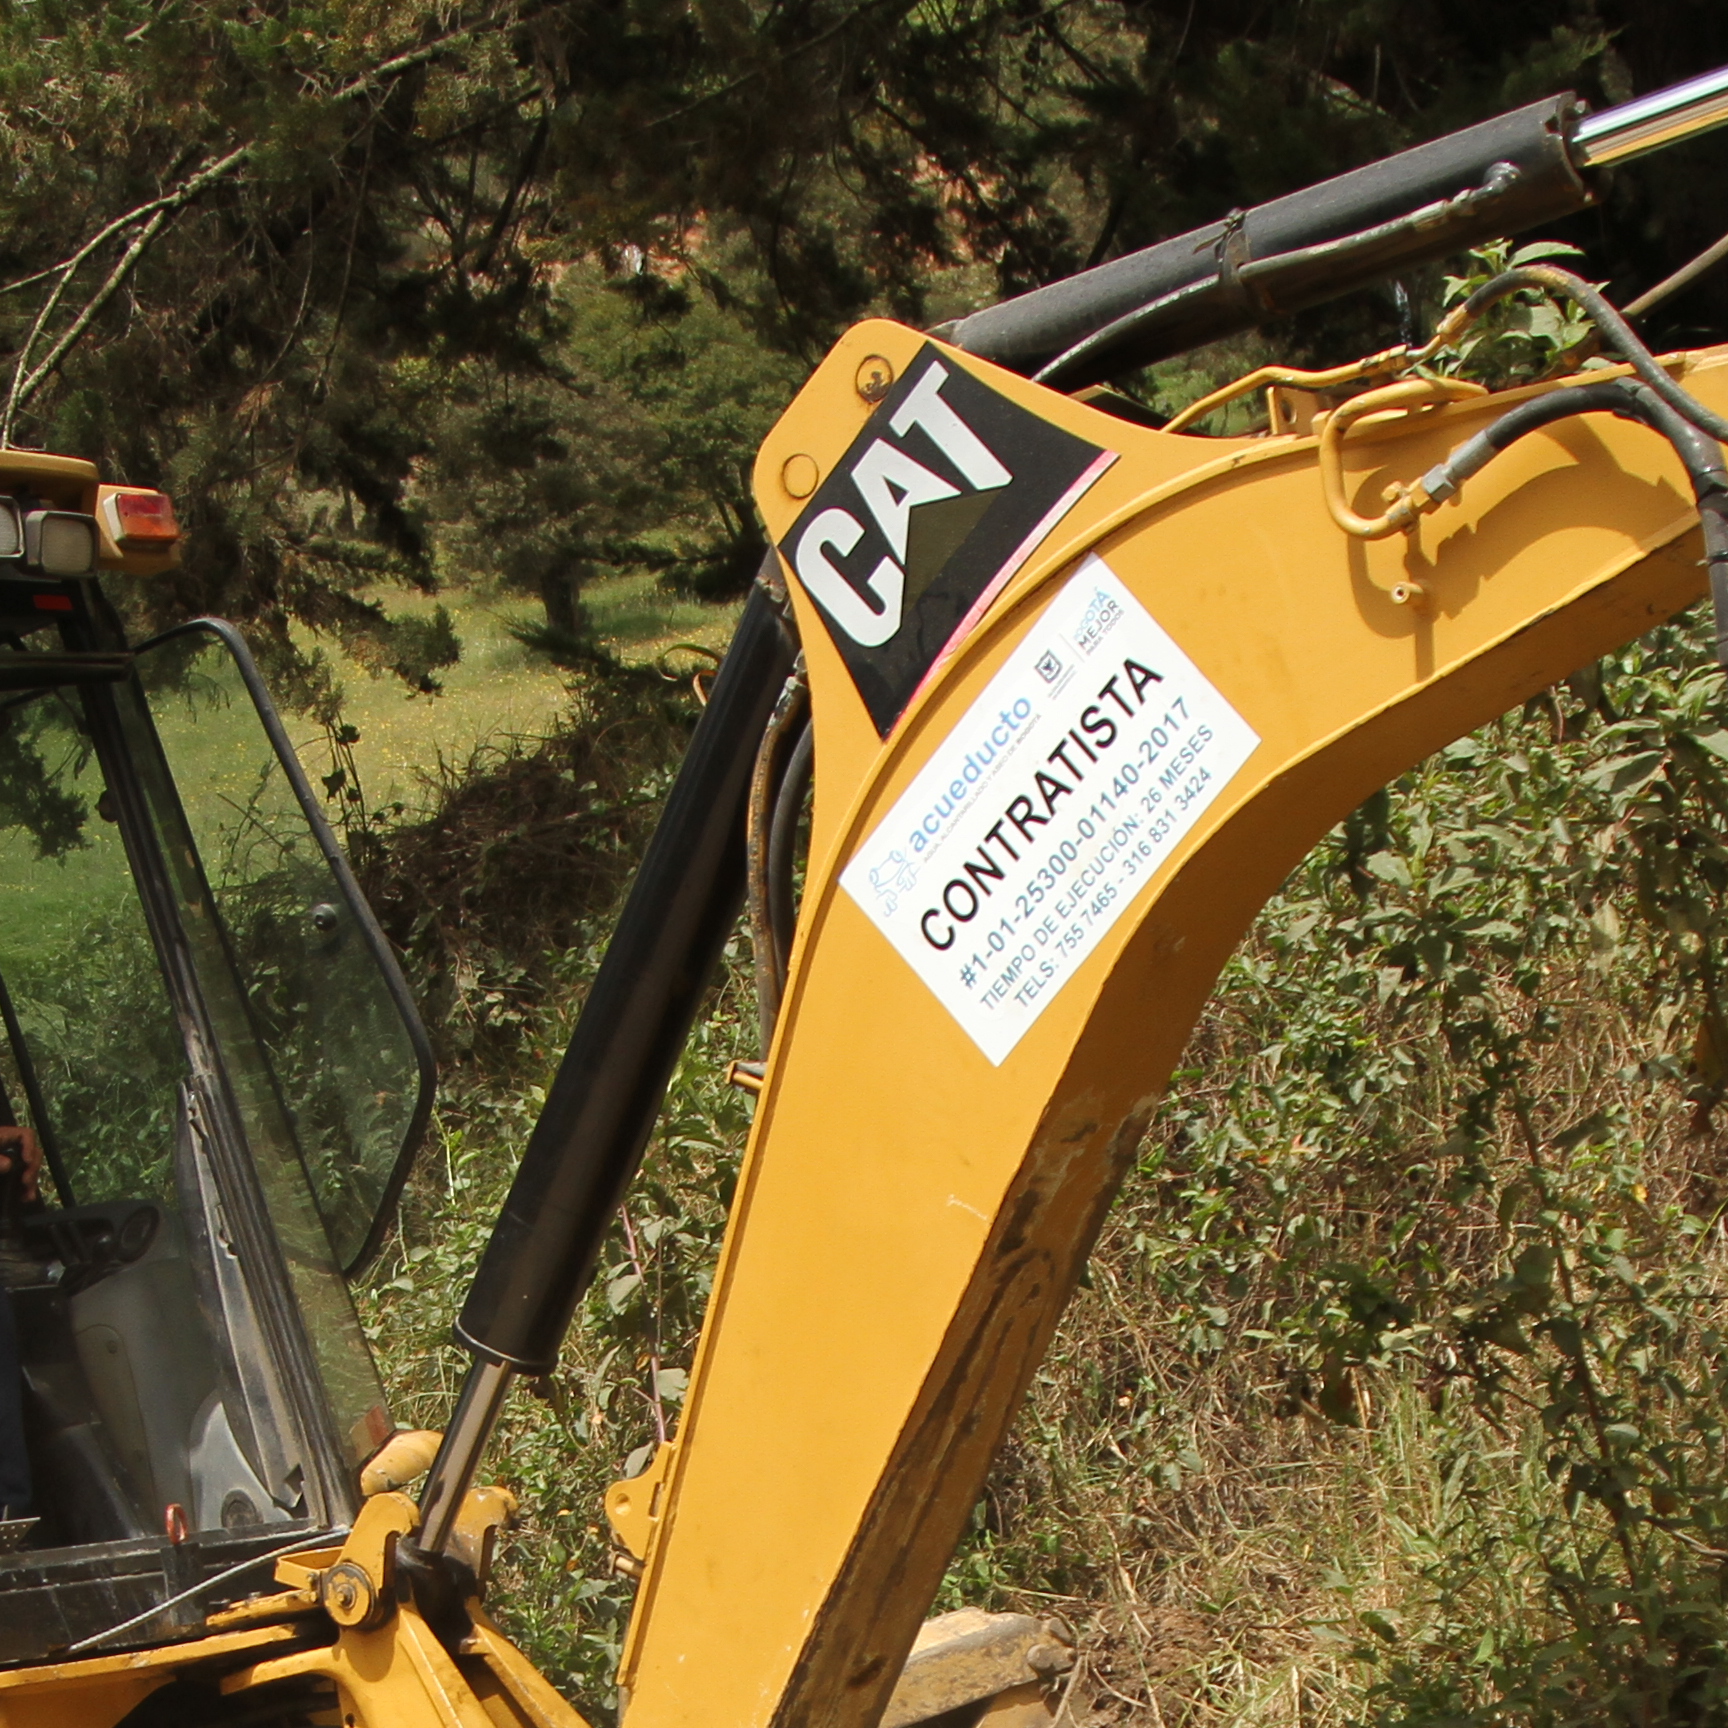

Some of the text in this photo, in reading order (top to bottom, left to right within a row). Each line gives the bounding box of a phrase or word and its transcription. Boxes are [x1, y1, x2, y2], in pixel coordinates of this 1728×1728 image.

[796, 361, 1013, 648] CAT
[1077, 598, 1119, 650] MEJOR
[908, 696, 1031, 852] acueducto
[920, 658, 1162, 951] CONTRATISTA
[959, 695, 1188, 988] #1-01-25300-01140-2017
[979, 723, 1213, 1009] TIEMPO DE EJECUCIÓN: 26 MESES
[1012, 958, 1059, 1007] TELS:
[1054, 922, 1084, 957] 755
[1079, 881, 1117, 925] 7465
[1121, 839, 1152, 875] 316
[1147, 808, 1176, 843] 831
[1174, 765, 1211, 811] 3424
